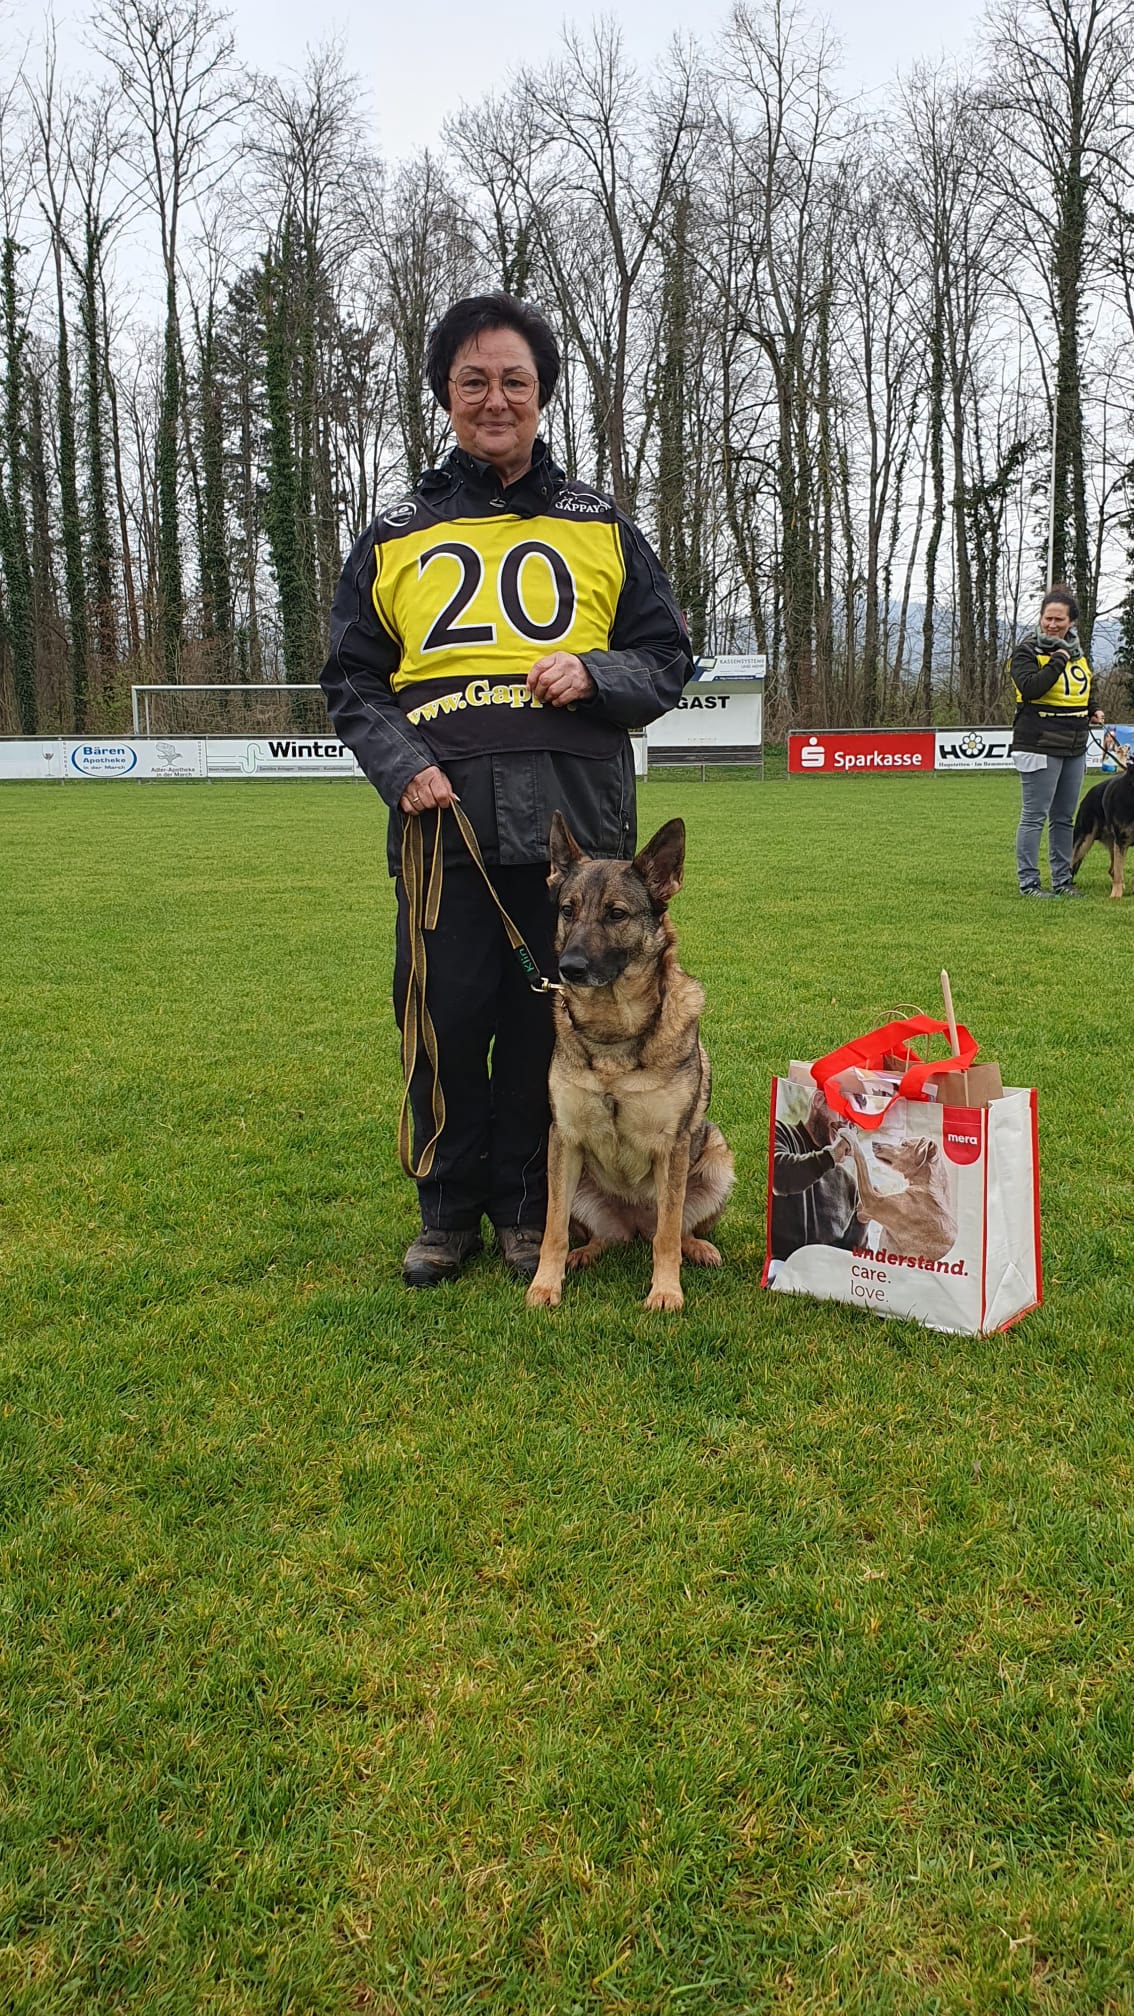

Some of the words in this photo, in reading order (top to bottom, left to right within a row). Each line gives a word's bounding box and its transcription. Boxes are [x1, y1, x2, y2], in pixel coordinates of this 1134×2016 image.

[555, 501, 600, 513] GAPPAY
[417, 539, 577, 654] 20
[1062, 665, 1088, 696] 19
[677, 695, 730, 710] GAST
[83, 746, 125, 755] Bären
[268, 741, 349, 758] Winter
[834, 750, 922, 771] Sparkasse
[947, 1133, 978, 1145] mera
[852, 1246, 968, 1276] understand.
[851, 1265, 892, 1284] care.
[850, 1280, 889, 1302] love.
